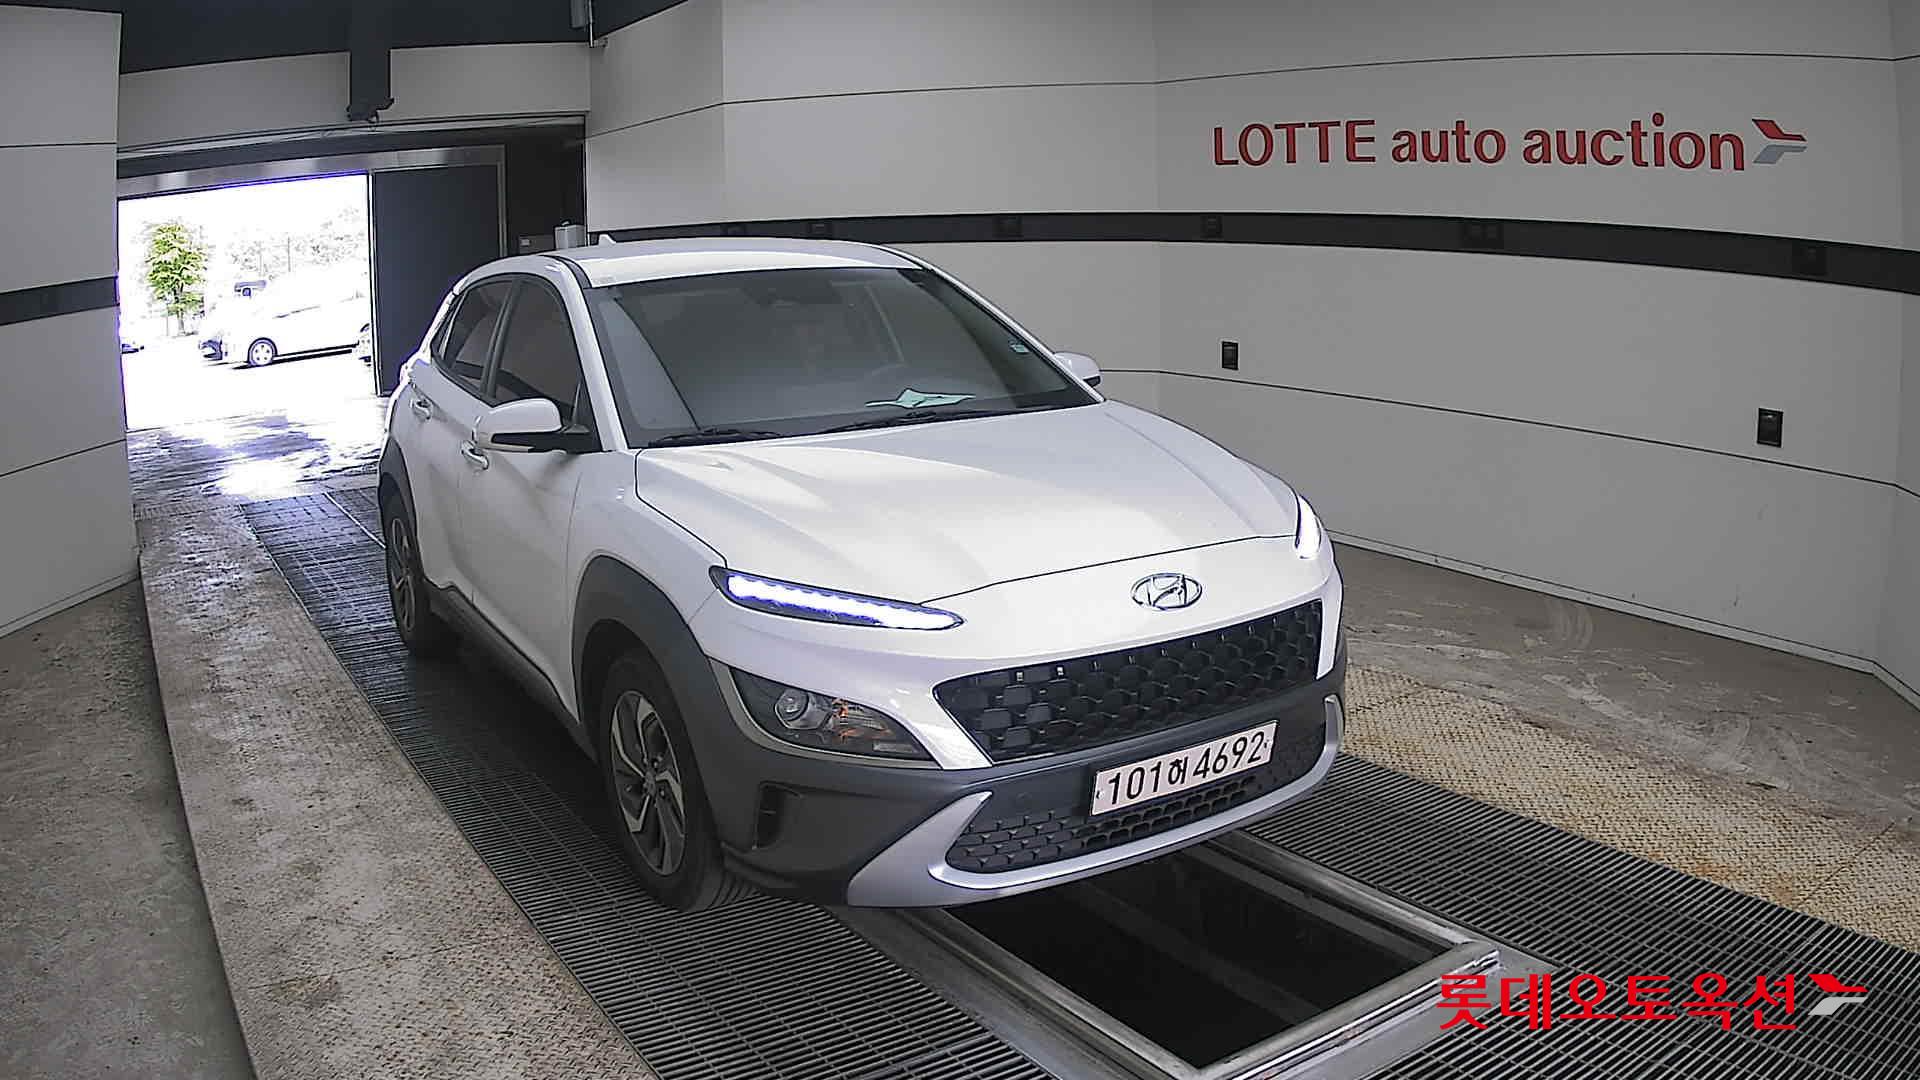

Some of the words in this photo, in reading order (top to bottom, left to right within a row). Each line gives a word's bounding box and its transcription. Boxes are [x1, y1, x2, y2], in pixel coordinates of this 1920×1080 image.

[1213, 119, 1376, 166] LOTTE
[1392, 119, 1506, 164] auto
[1523, 112, 1746, 171] auction
